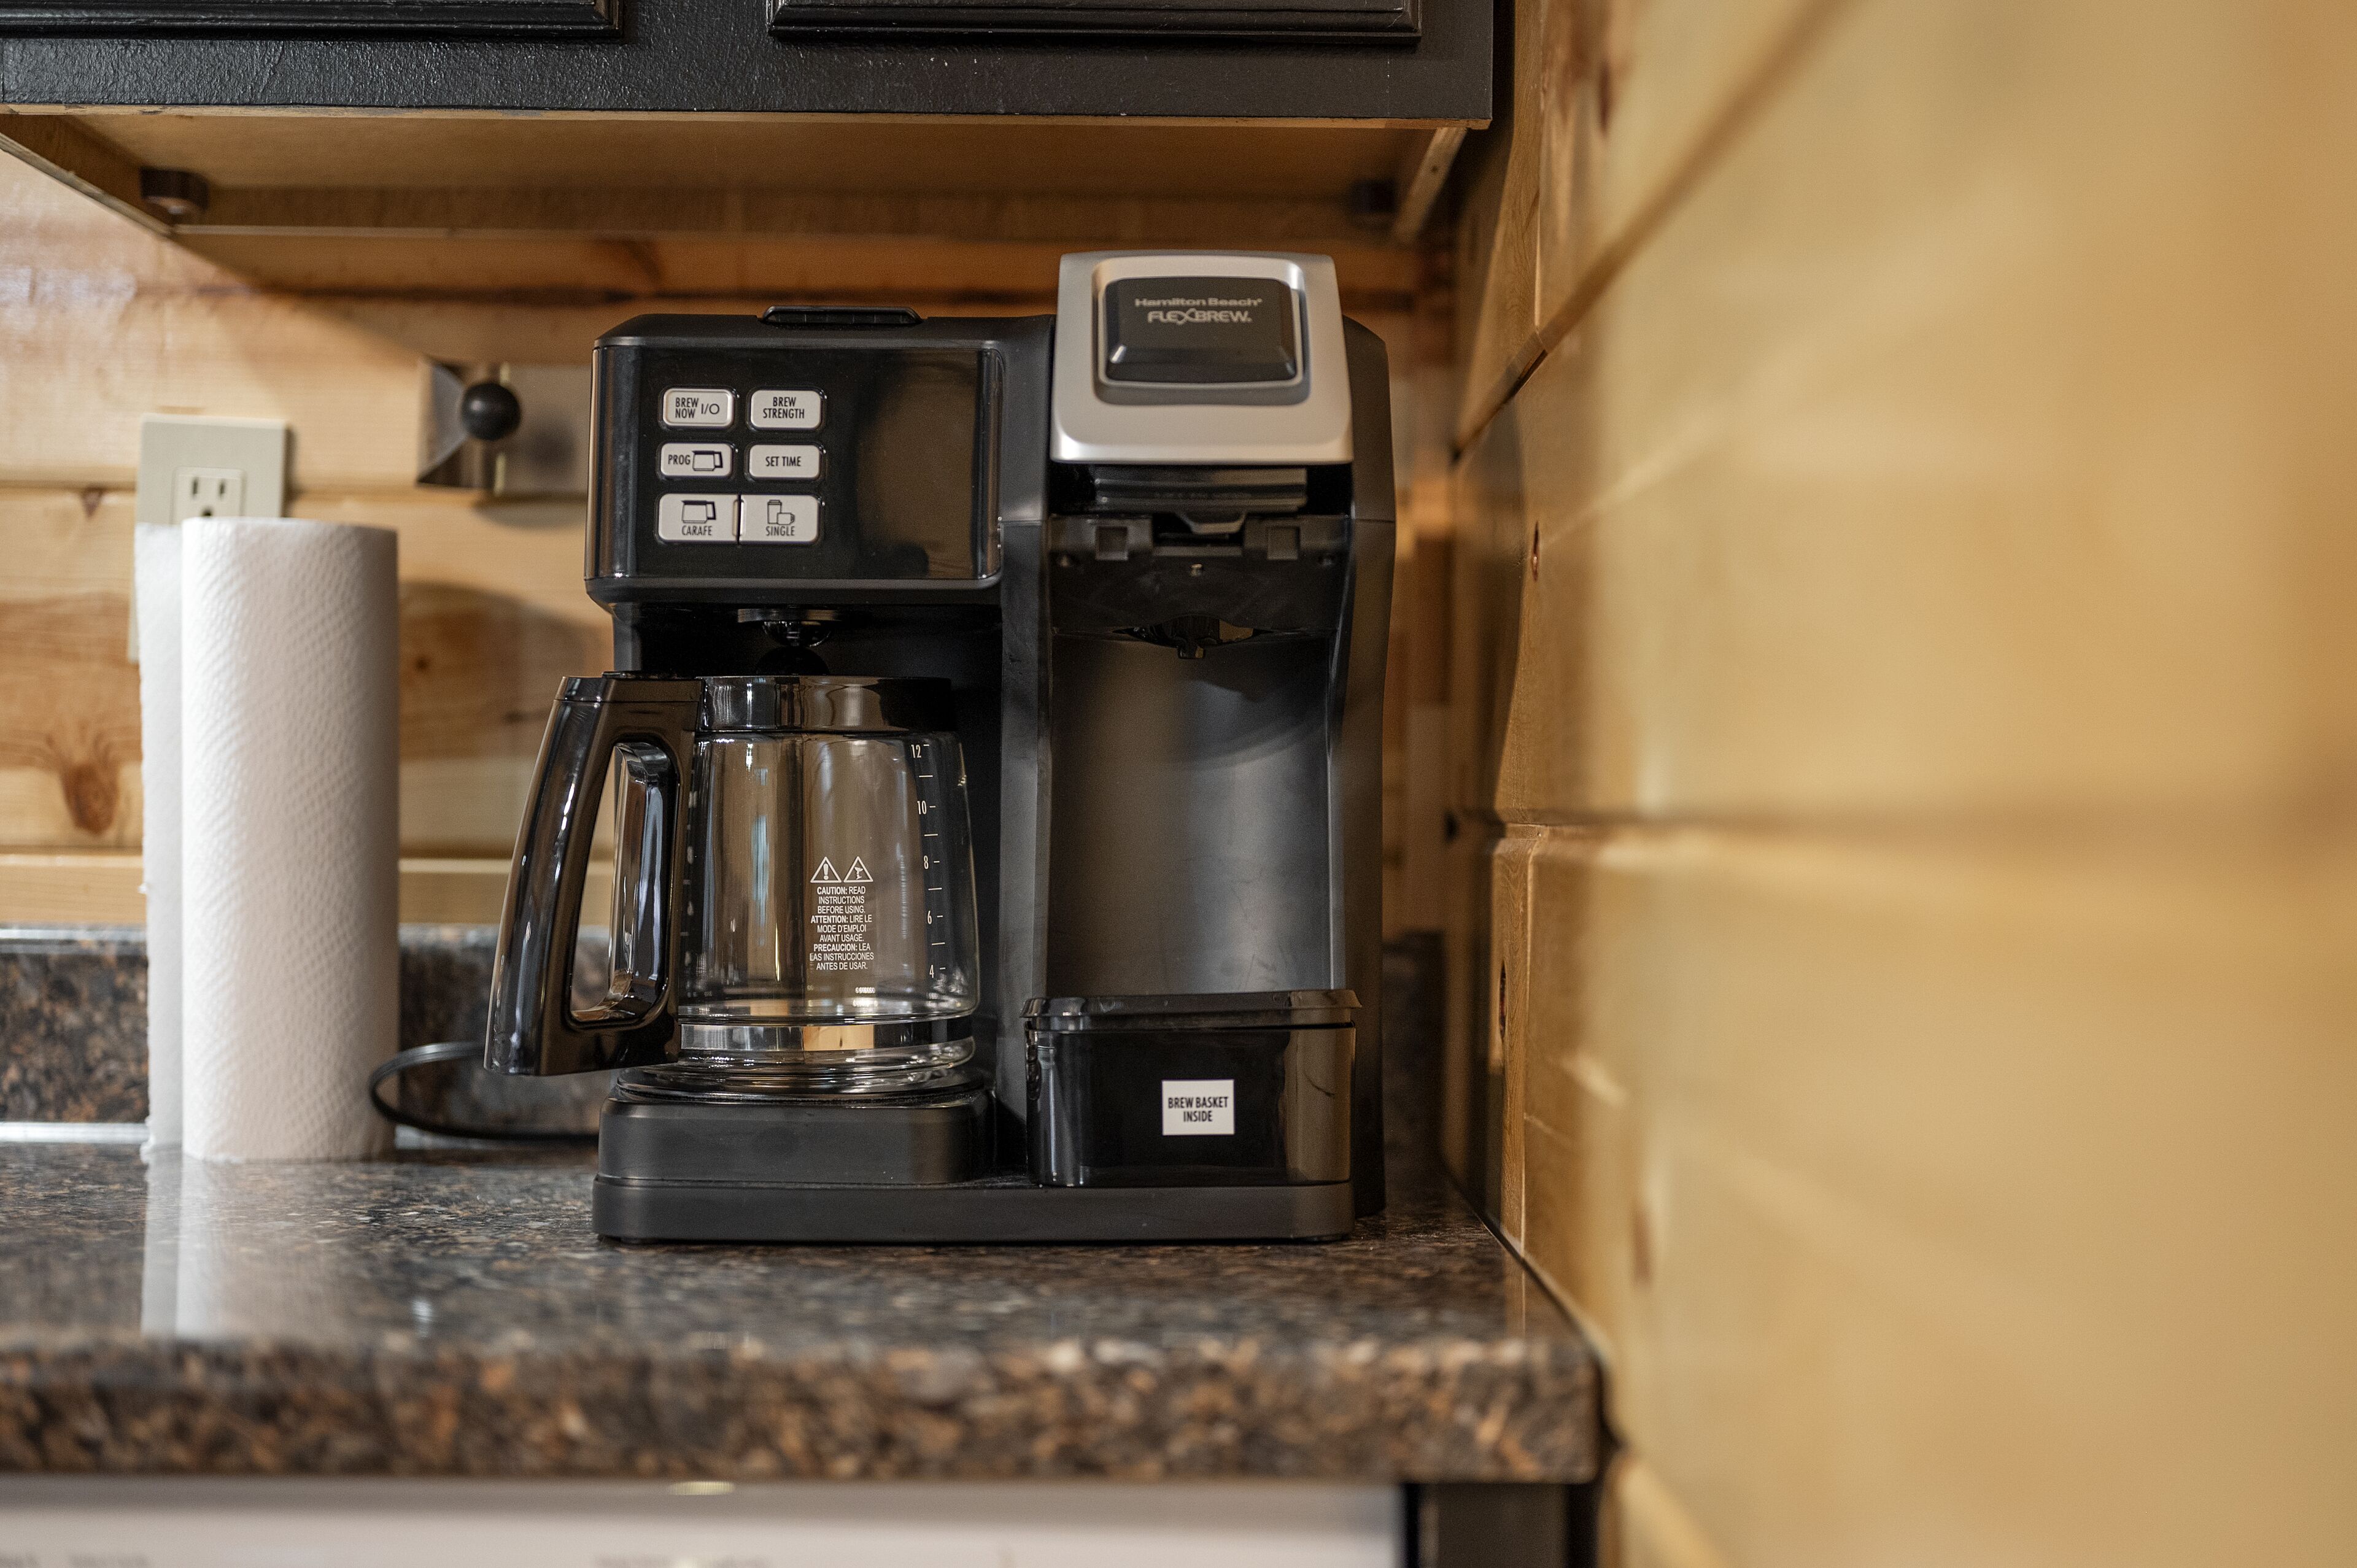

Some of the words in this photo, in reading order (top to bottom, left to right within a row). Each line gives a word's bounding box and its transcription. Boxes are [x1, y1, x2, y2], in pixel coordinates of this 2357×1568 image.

[675, 398, 699, 407] BREW
[773, 396, 796, 407] BREW
[675, 409, 695, 419] NOW
[763, 408, 805, 419] STRENGTH
[668, 455, 691, 465] PROG
[765, 456, 779, 466] SET
[782, 457, 801, 466] TIME
[681, 525, 712, 536] CARAFE
[765, 526, 795, 536] SINGLE
[911, 744, 921, 759] 12
[917, 800, 927, 815] 10
[924, 855, 929, 869] 8
[927, 911, 932, 924] 6
[929, 965, 934, 978] 4
[1168, 1097, 1194, 1108] BREW
[1196, 1097, 1228, 1108] BASKET
[1183, 1111, 1213, 1122] INSIDE
